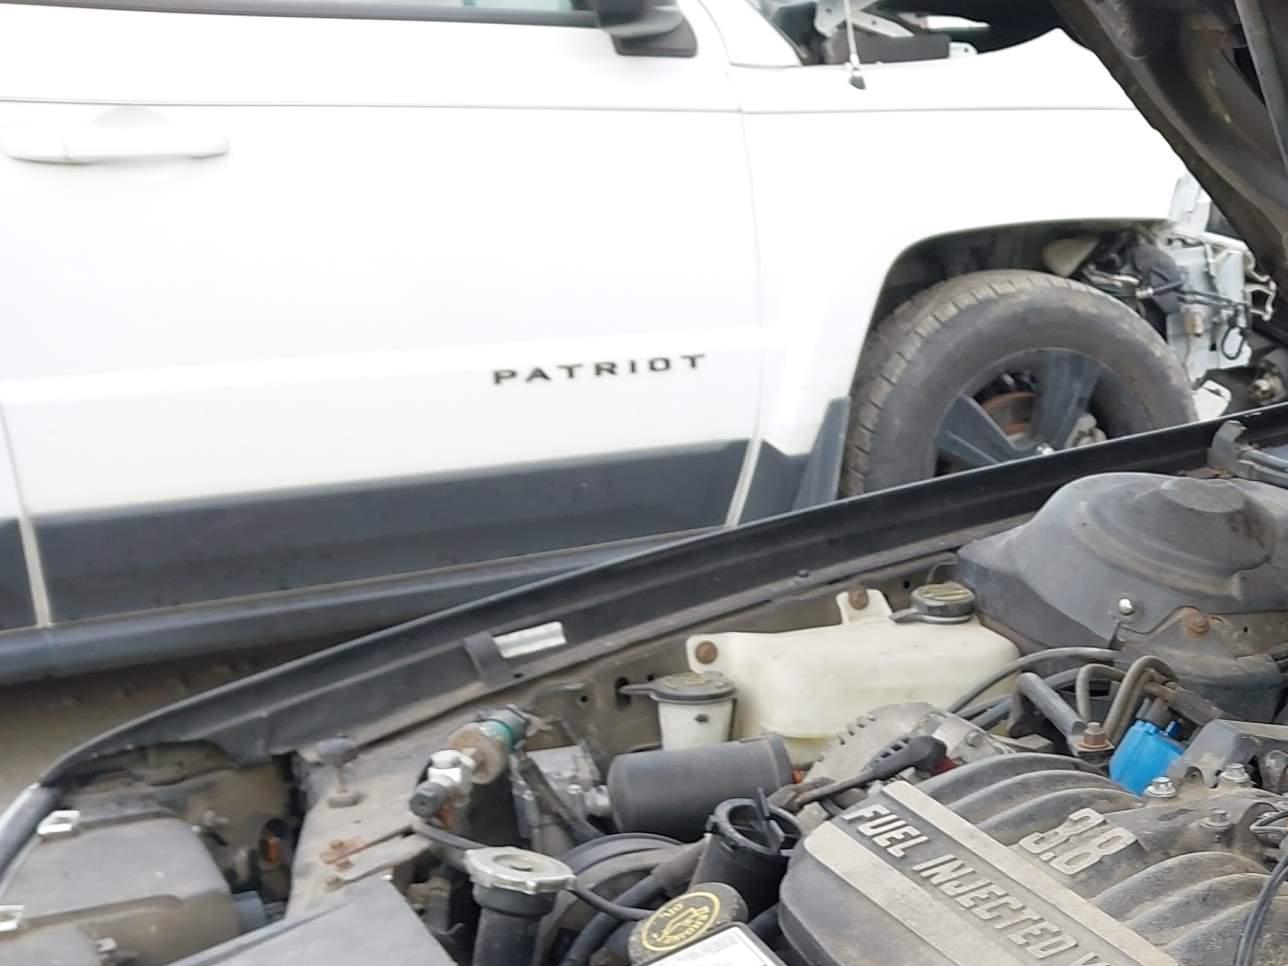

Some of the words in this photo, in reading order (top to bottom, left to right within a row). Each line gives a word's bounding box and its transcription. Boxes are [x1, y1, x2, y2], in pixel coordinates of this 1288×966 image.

[493, 354, 705, 384] PATRIOT
[1019, 807, 1136, 875] 3.8
[841, 804, 928, 857] FUEL
[913, 854, 1077, 959] INJECTED
